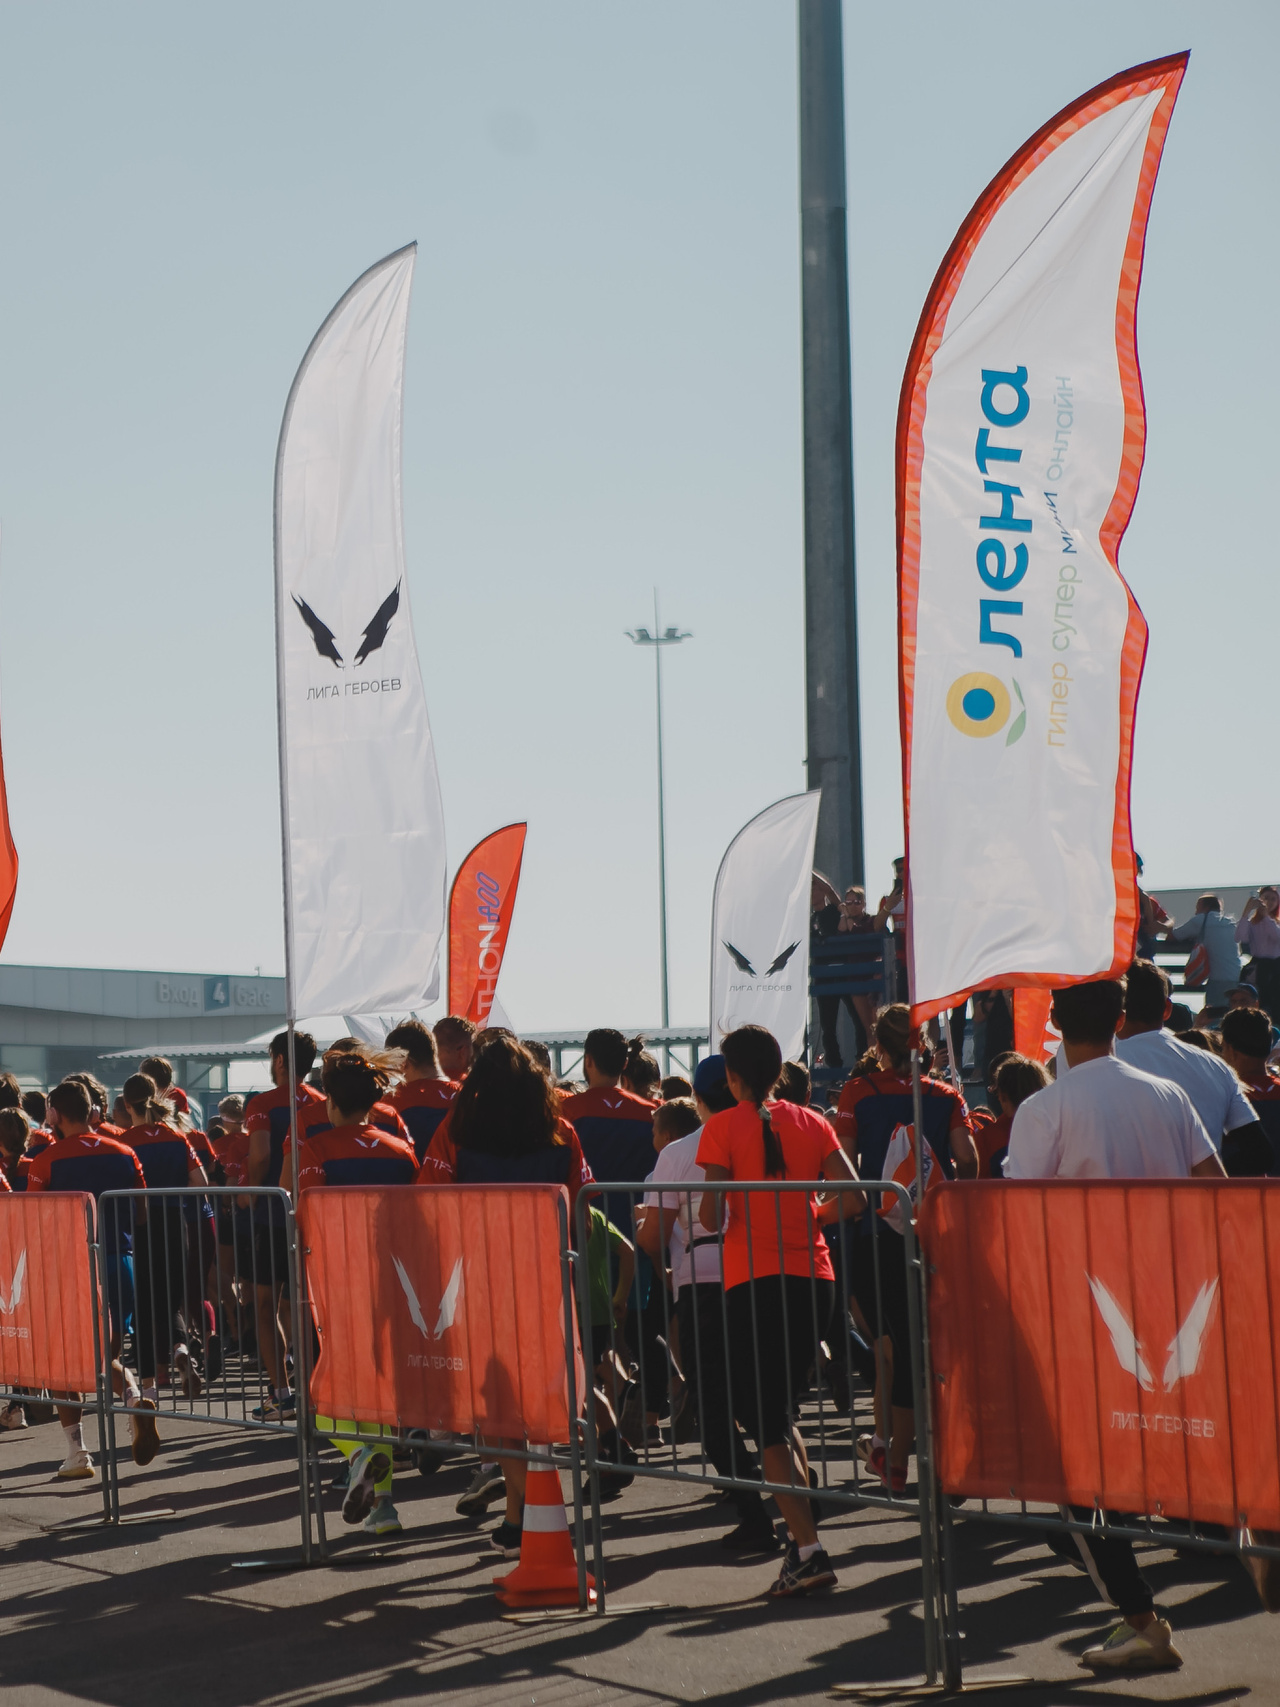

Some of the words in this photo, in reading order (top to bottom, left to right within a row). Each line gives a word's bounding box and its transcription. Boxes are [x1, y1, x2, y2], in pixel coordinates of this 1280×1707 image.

[1046, 375, 1074, 482] онлайн
[975, 365, 1033, 659] лента
[1052, 564, 1083, 652] супер
[306, 684, 340, 701] ЛИГА
[344, 678, 402, 696] ГЕРОЕВ
[157, 978, 199, 1007] Вход
[213, 982, 226, 1004] 4
[234, 984, 272, 1007] Gate
[756, 984, 792, 992] ГЕРОЕВ
[431, 1355, 464, 1372] ГЕРОЕВ
[1110, 1411, 1150, 1430] ЛИГА
[1153, 1414, 1216, 1438] ГЕРОЕВ
